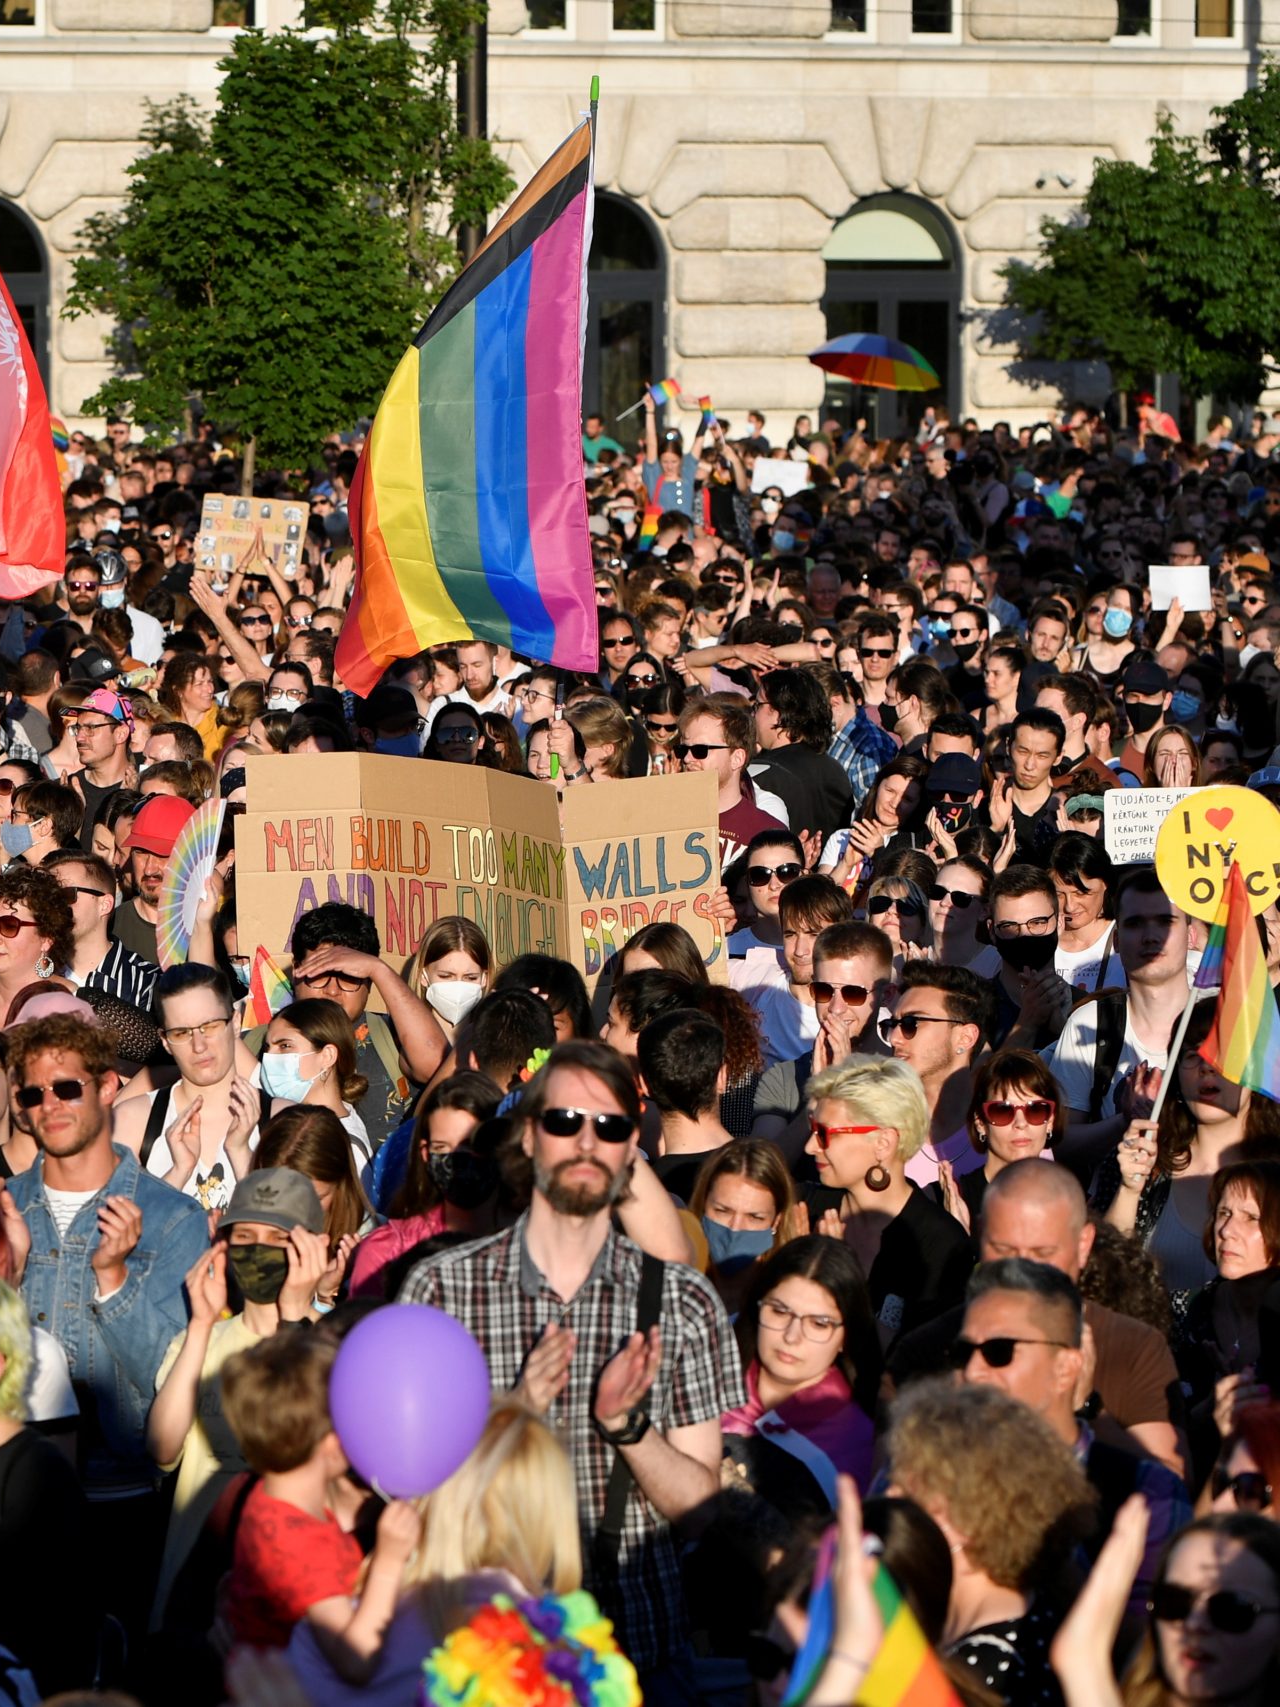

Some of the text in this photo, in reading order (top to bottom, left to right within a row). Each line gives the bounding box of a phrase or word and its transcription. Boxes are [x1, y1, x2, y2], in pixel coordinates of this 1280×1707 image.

[1155, 809, 1170, 817] TIT
[1183, 811, 1191, 834] I
[1114, 837, 1155, 848] LEGYETEK
[264, 816, 334, 873] MEN
[350, 815, 431, 877] BUILD
[442, 824, 499, 885] TOO
[501, 831, 567, 899] MANY
[573, 832, 713, 902] WALLS
[1113, 852, 1127, 862] AZ
[1189, 863, 1280, 904] OC!
